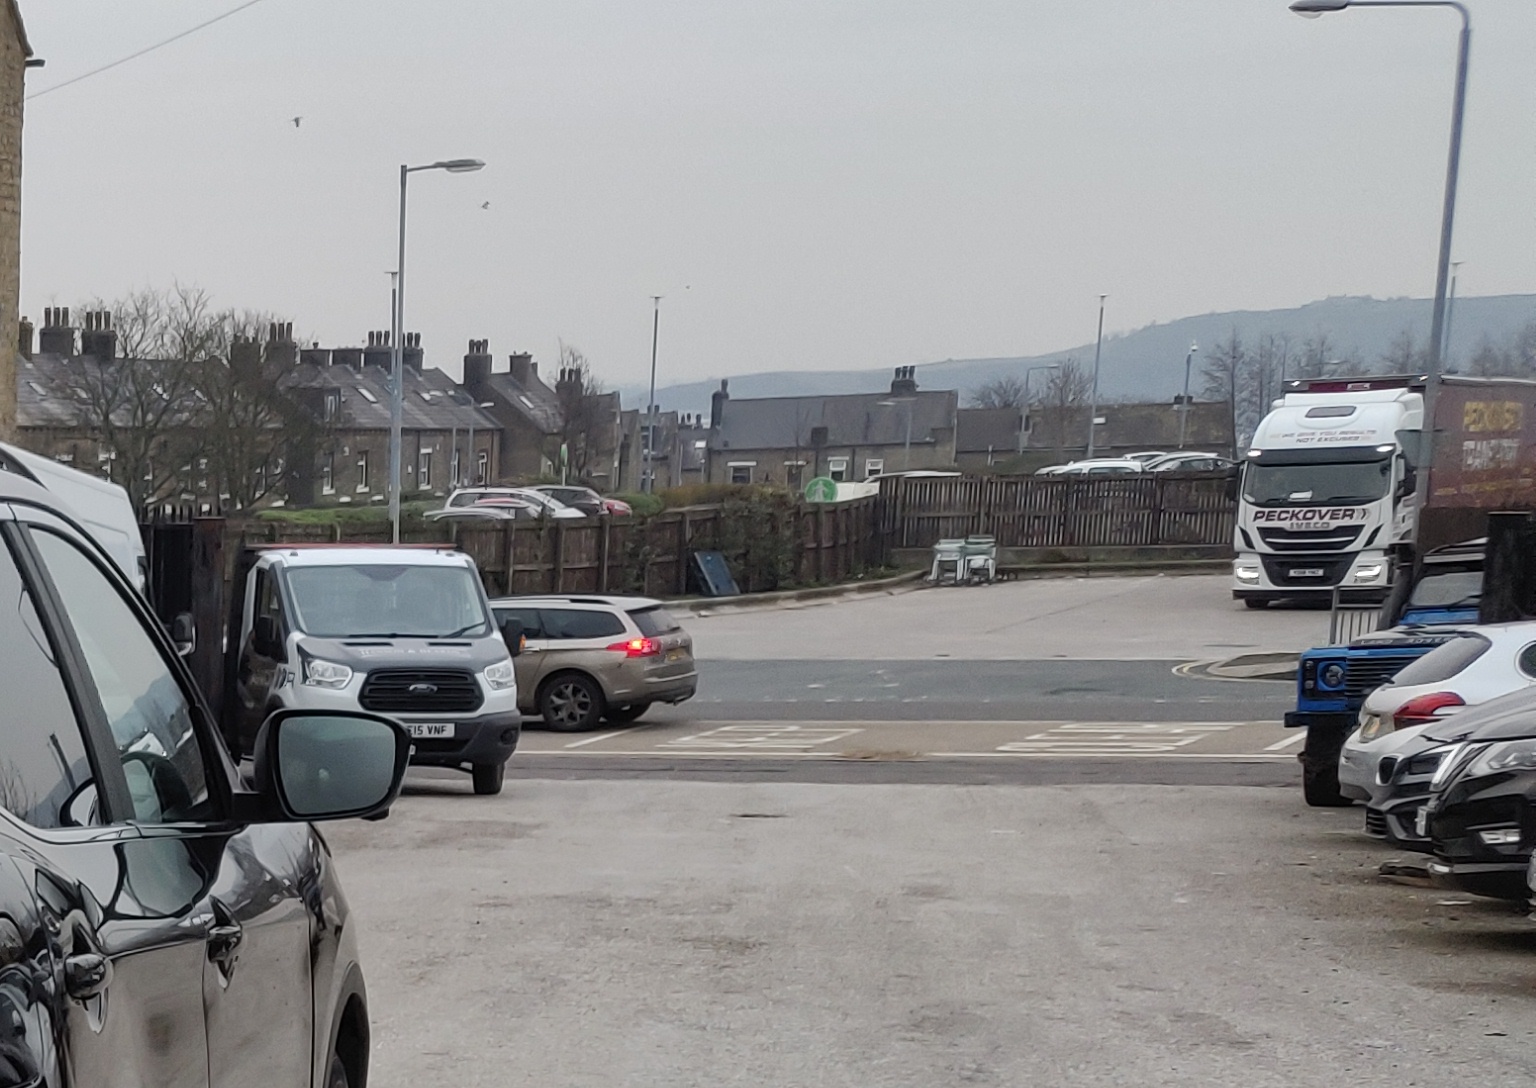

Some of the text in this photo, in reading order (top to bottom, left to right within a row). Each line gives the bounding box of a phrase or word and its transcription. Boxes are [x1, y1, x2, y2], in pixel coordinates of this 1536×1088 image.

[1252, 508, 1356, 522] PECKOVER
[1289, 521, 1330, 529] IVECO
[427, 724, 447, 735] VNF
